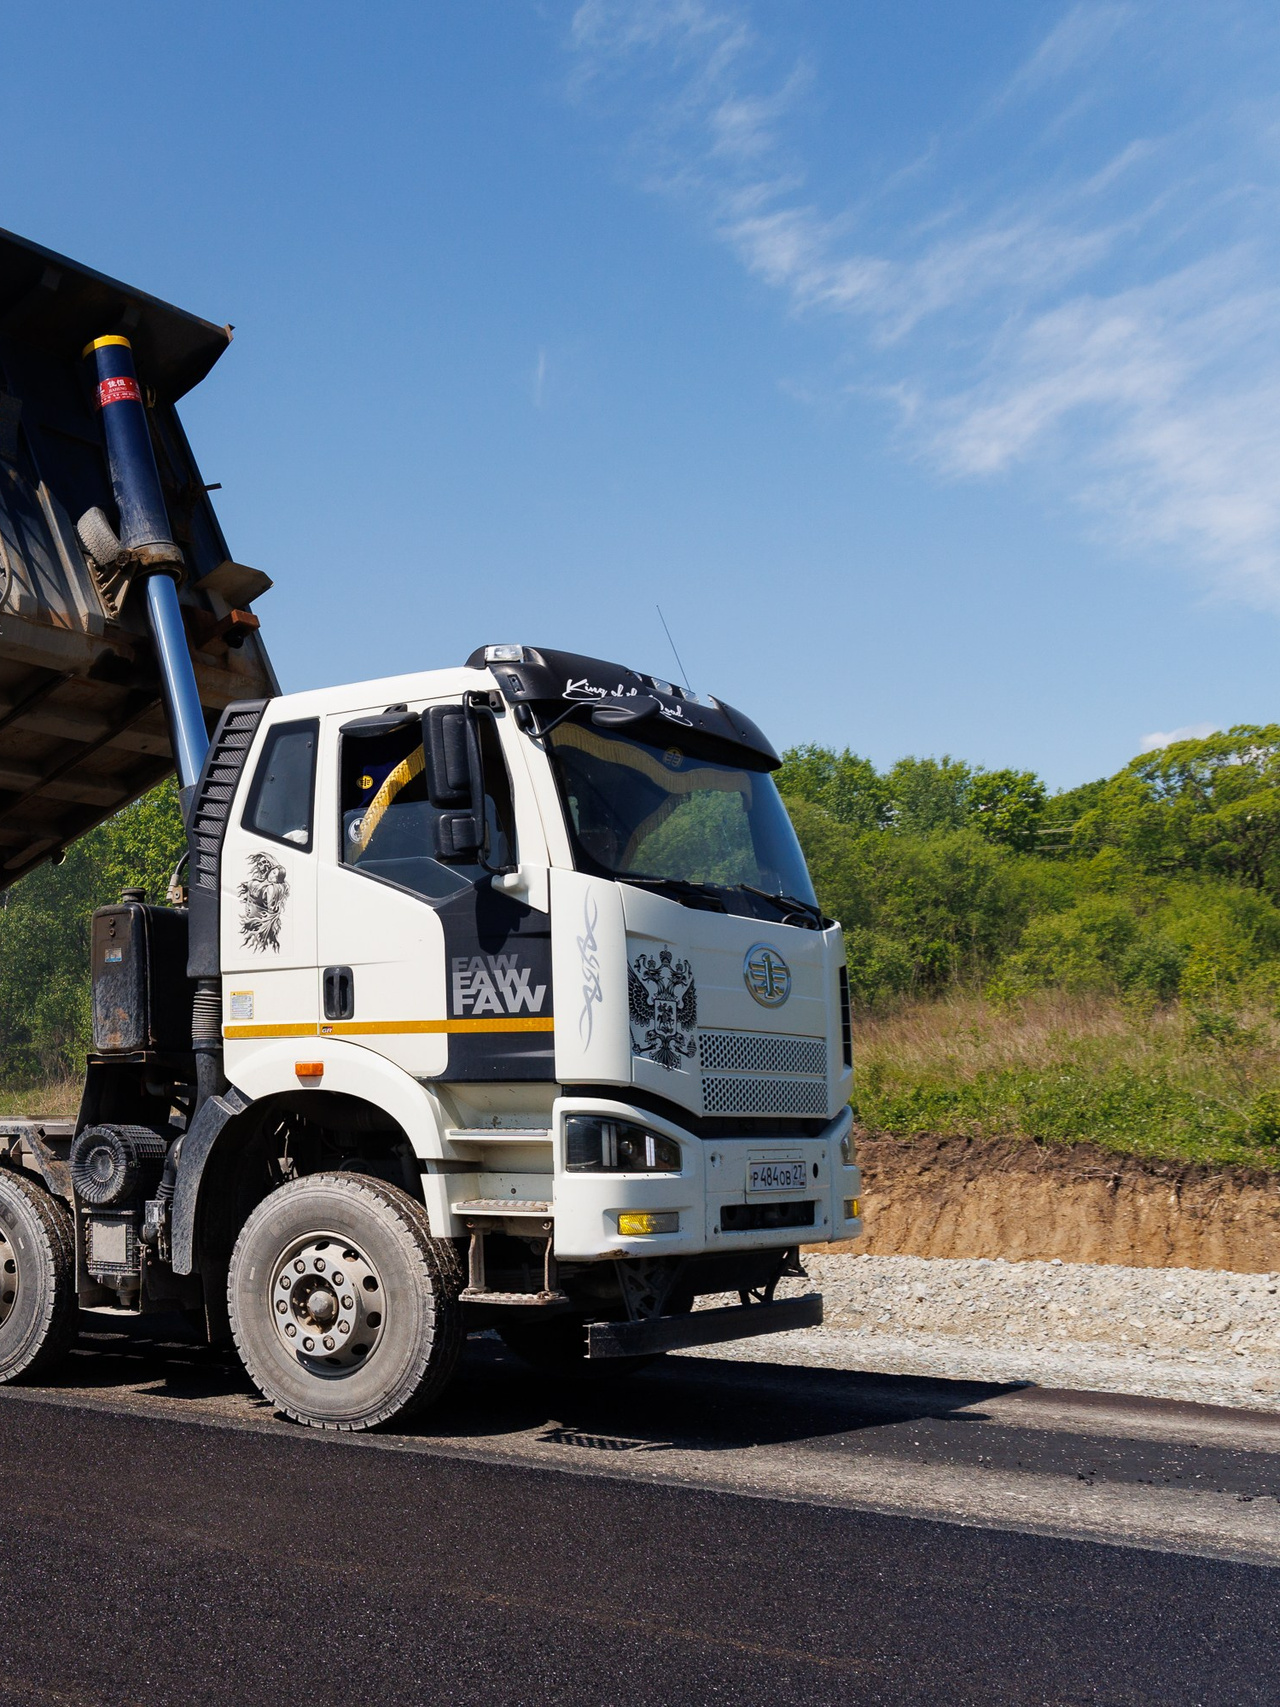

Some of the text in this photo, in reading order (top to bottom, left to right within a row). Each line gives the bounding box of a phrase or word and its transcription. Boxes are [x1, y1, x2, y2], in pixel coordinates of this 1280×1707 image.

[562, 679, 608, 701] King
[452, 954, 518, 974] FAW
[452, 968, 531, 992] FAW
[453, 985, 547, 1015] FAW
[793, 1164, 803, 1180] 27
